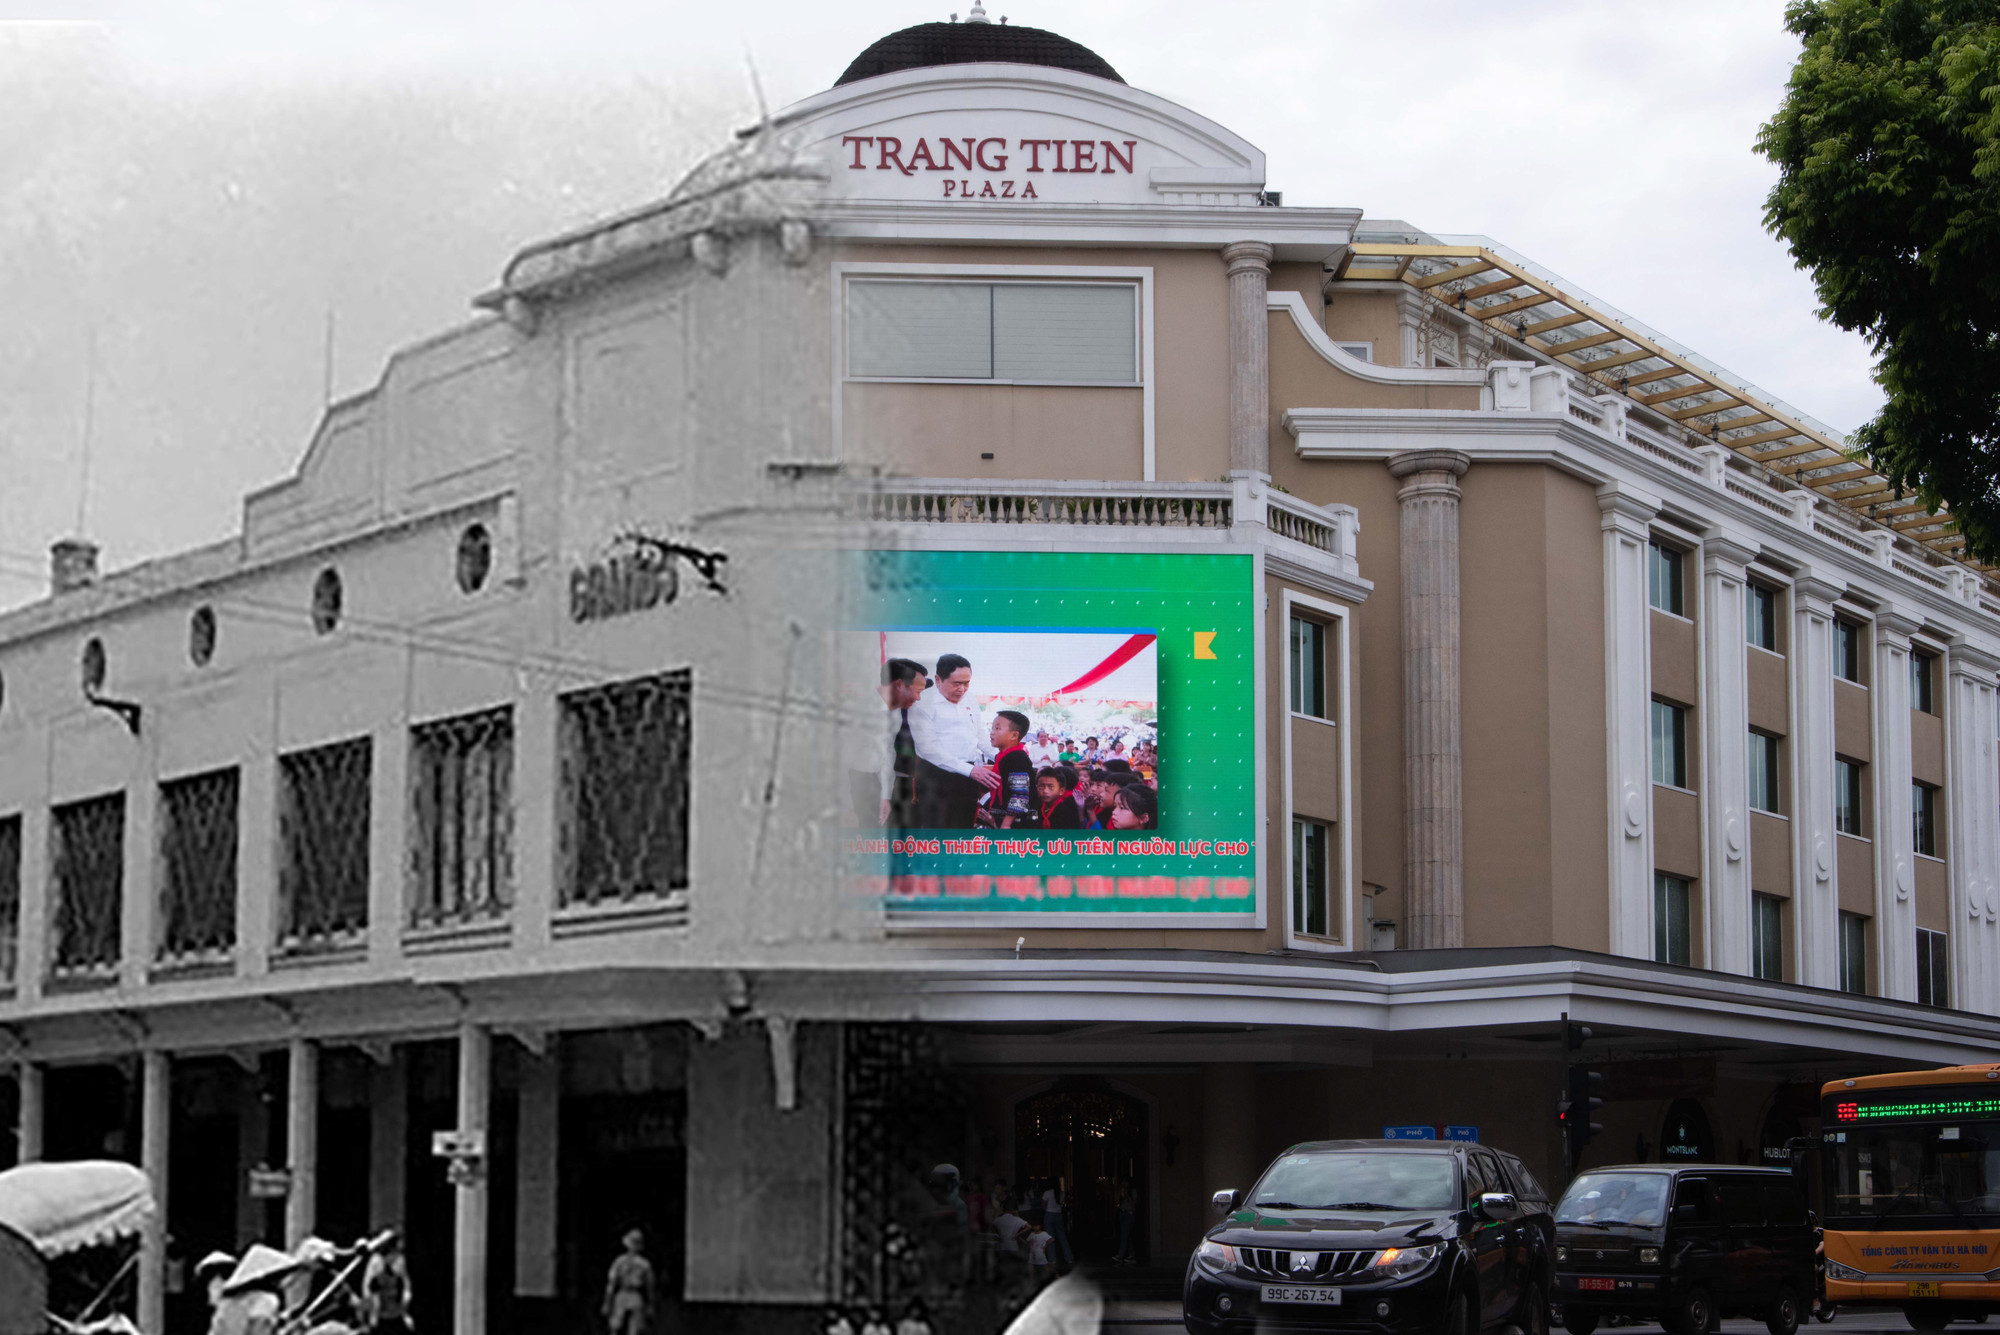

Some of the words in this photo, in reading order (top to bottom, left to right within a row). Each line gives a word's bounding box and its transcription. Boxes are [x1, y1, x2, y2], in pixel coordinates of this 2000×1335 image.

[842, 136, 1008, 176] TRANG
[1020, 139, 1137, 174] TIEN
[943, 179, 1038, 199] PLAZA
[892, 836, 940, 857] ĐỘNG
[943, 836, 991, 854] THIẾT
[995, 838, 1044, 857] THỰC,
[1048, 839, 1071, 855] ƯU
[1075, 837, 1113, 855] TIÊN
[1118, 837, 1176, 856] NGUỒN
[1180, 839, 1211, 858] LỰC
[1215, 841, 1249, 856] CHO
[1406, 1127, 1423, 1136] PHỐ
[1666, 1145, 1698, 1155] MONTBLANC
[1764, 1147, 1791, 1158] HUBLOT
[1861, 1244, 1882, 1256] TỔNG
[1885, 1244, 1907, 1256] CÔNG
[1910, 1246, 1919, 1255] TY
[1922, 1245, 1939, 1256] VẬN
[1941, 1242, 1955, 1255] TẢI
[1957, 1243, 1969, 1254] HÀ
[1972, 1243, 1988, 1256] NỘI
[1267, 1288, 1335, 1302] 99C-267.54
